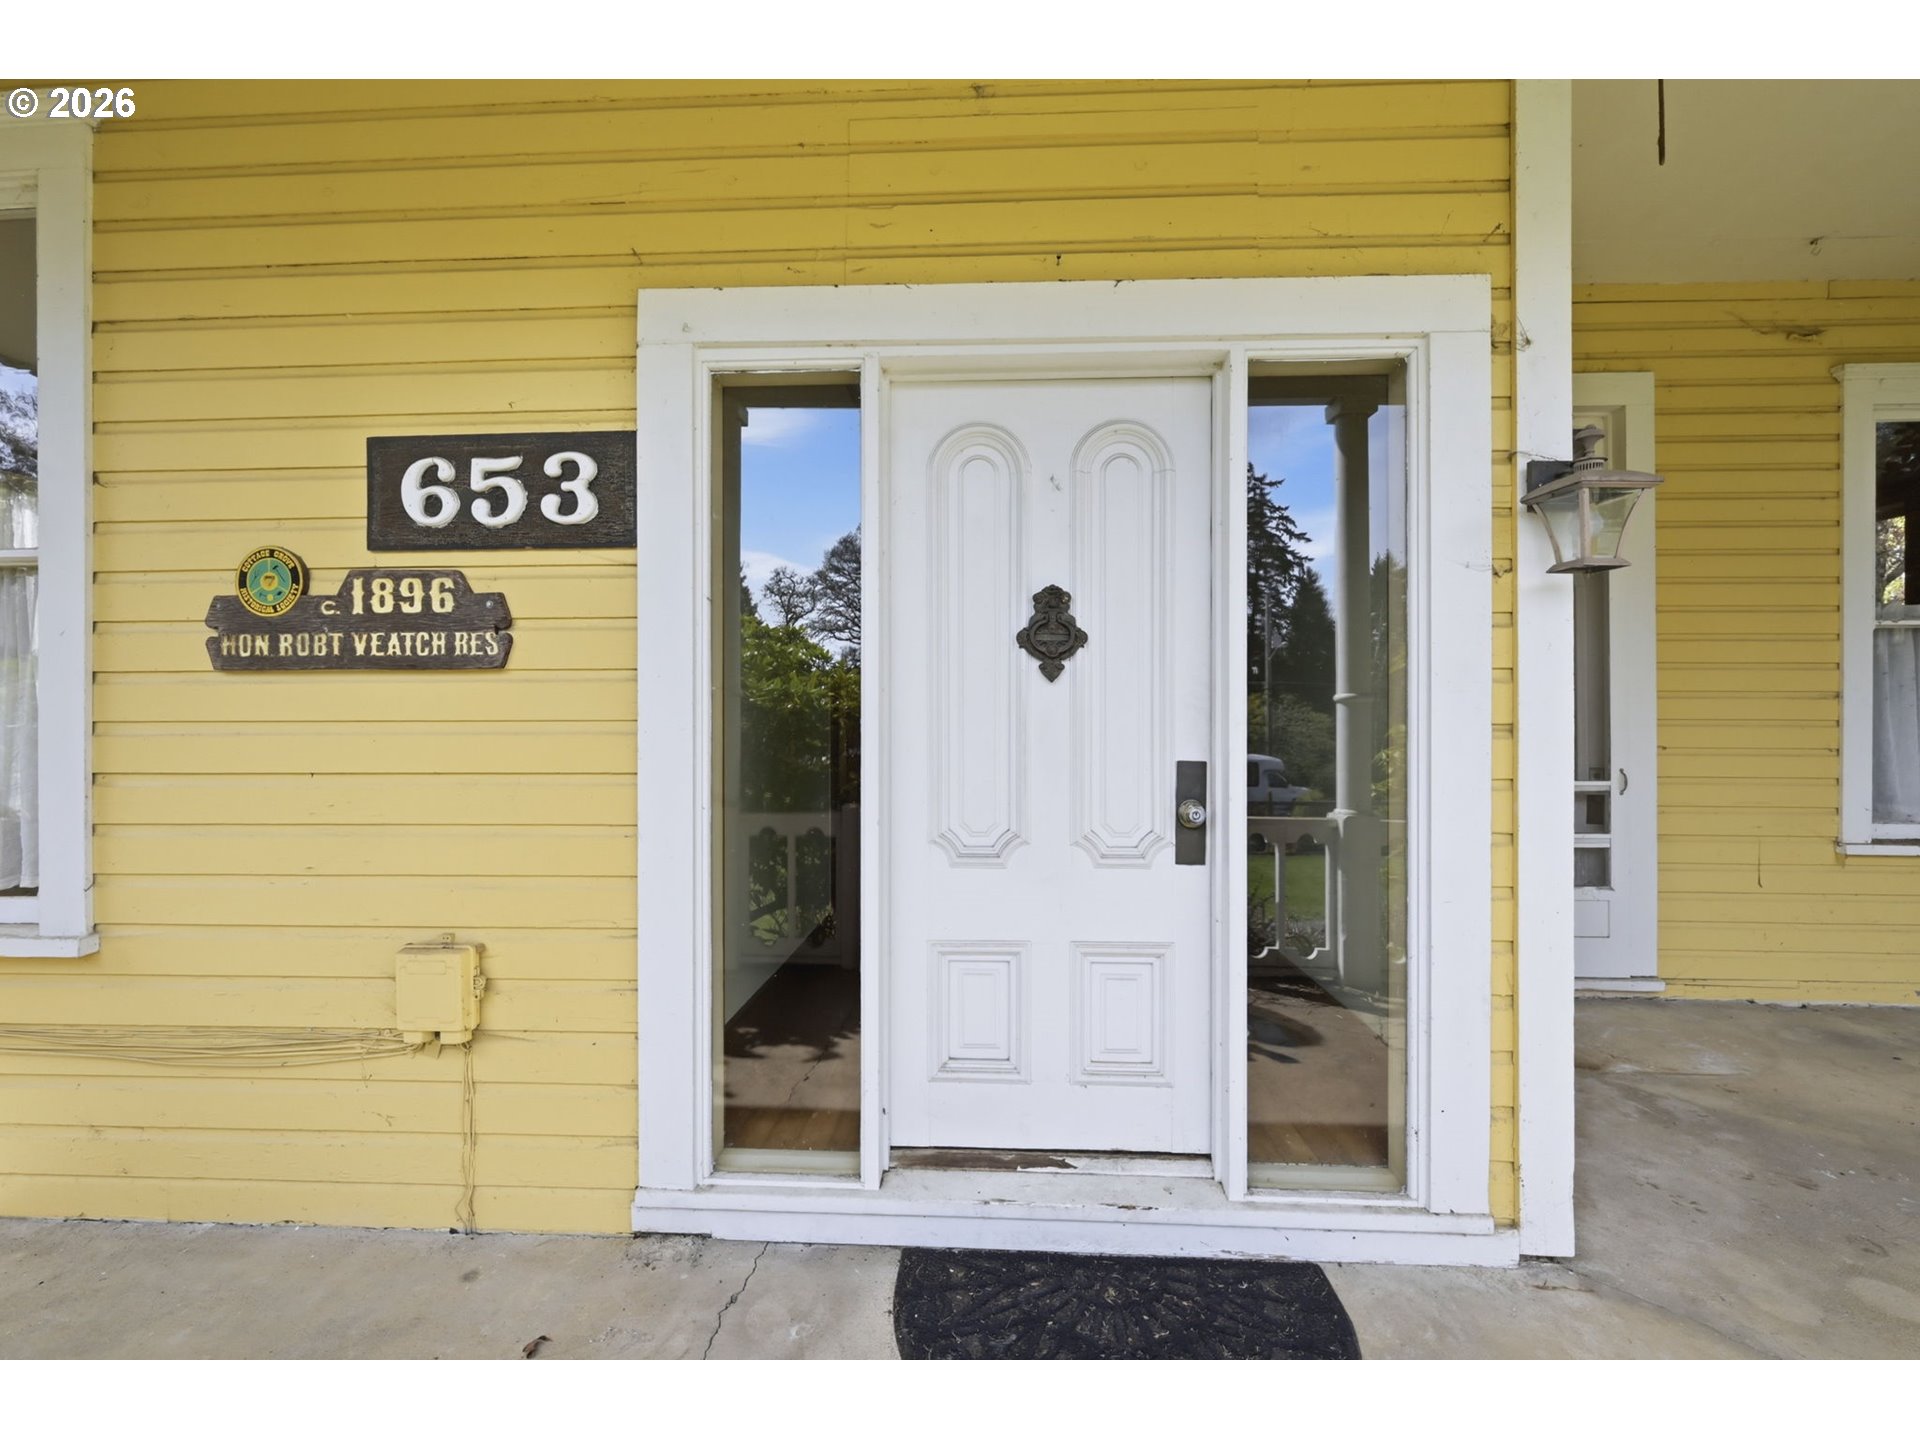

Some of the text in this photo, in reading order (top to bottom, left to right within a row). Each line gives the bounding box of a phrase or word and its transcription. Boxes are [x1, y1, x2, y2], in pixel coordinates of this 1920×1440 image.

[401, 451, 599, 529] 653
[241, 549, 295, 573] COTTAGE GROVE
[240, 582, 299, 613] HISTORICAL SOCIETY
[351, 576, 455, 615] 1896
[351, 632, 447, 656] VEATCH
[454, 631, 498, 655] RES
